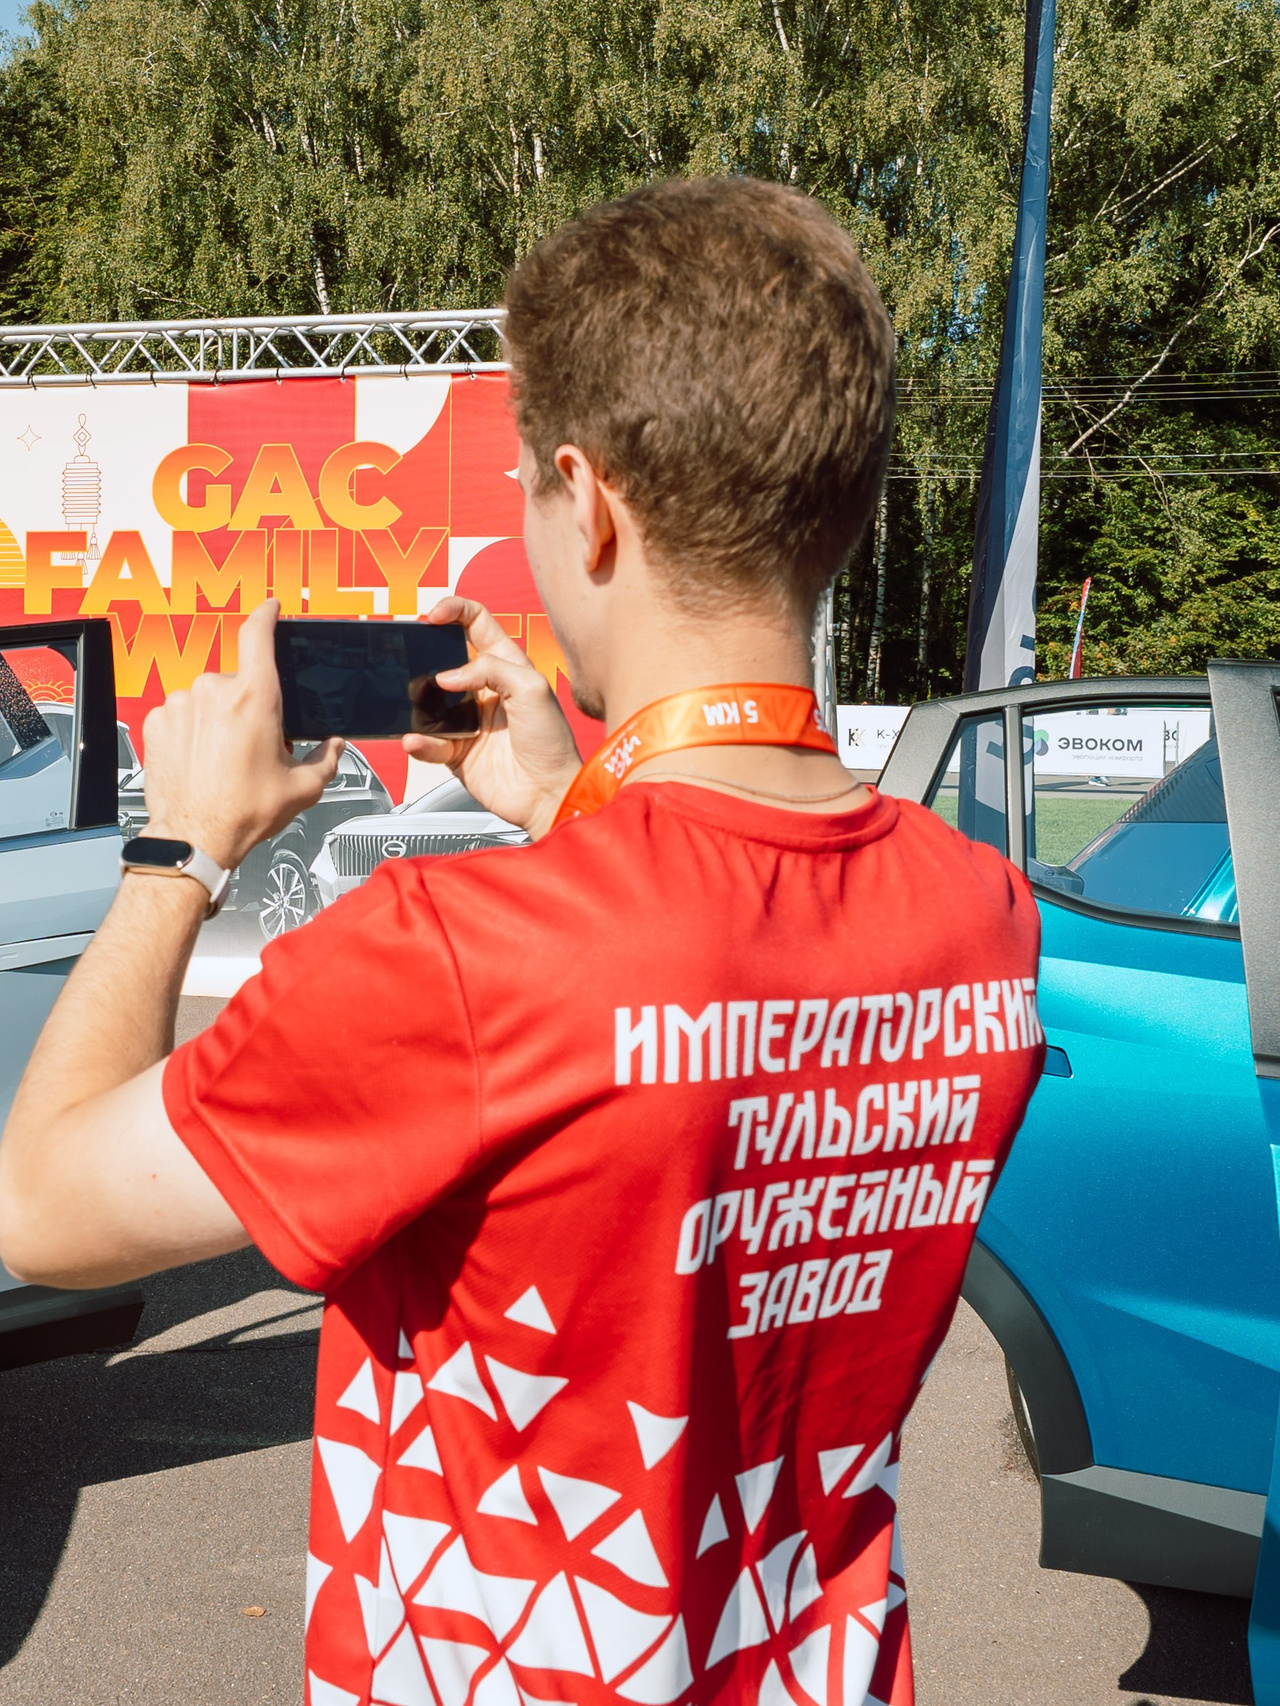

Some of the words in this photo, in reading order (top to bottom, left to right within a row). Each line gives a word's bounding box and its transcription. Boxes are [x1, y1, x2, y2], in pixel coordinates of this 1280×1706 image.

[152, 441, 404, 532] GAC
[23, 527, 450, 615] FAMILY
[743, 700, 759, 724] 5
[1058, 737, 1143, 752] ЭВОКОМ
[615, 977, 1042, 1086] ИМПЕРАТОРСКИЙ
[727, 1074, 981, 1170] ТУЛЬСКИЙ
[675, 1159, 995, 1275] ОРУЖЕЙНЫЙ
[727, 1249, 892, 1340] ЗАВОД
